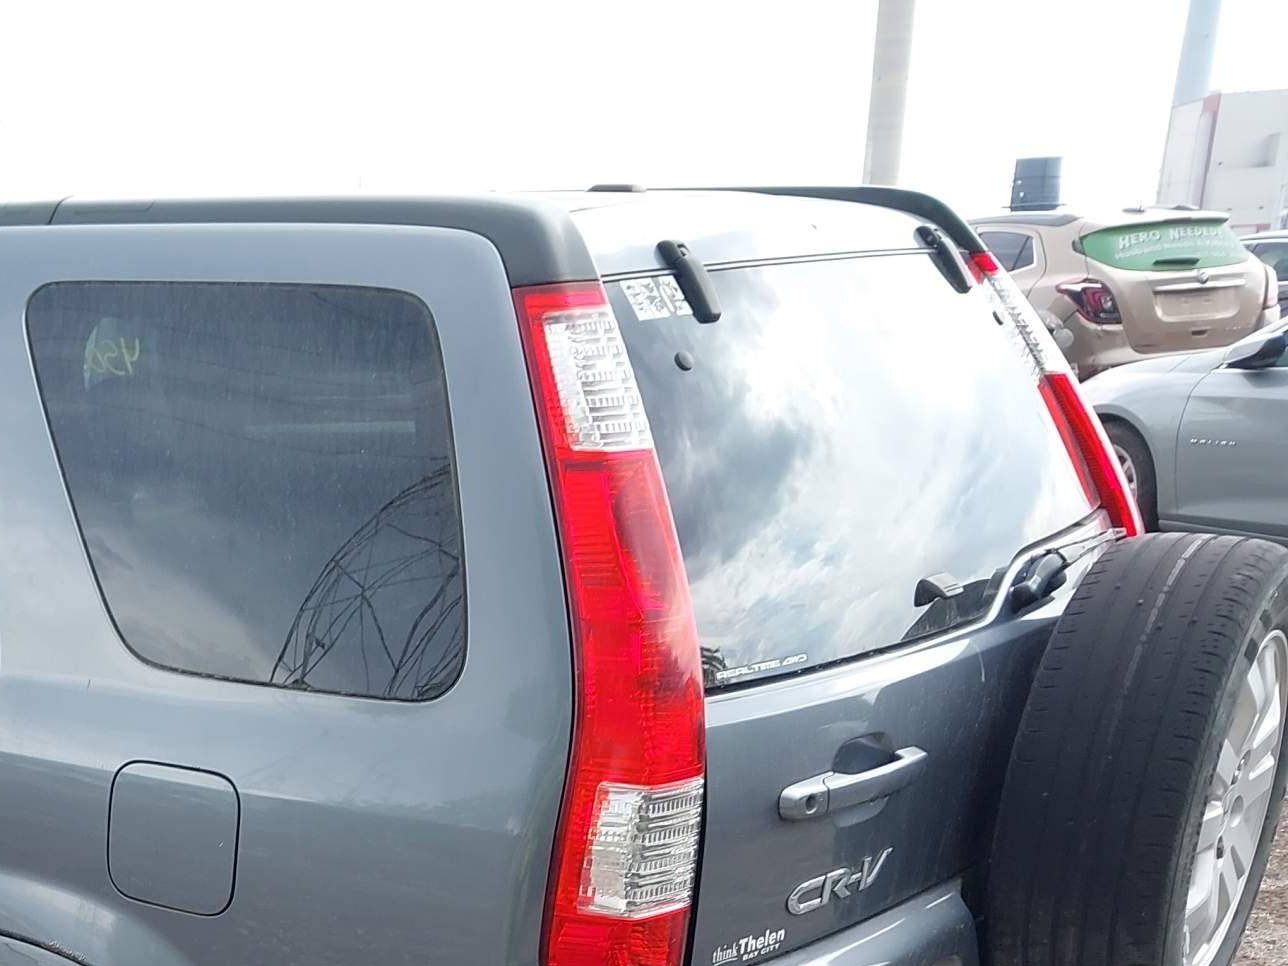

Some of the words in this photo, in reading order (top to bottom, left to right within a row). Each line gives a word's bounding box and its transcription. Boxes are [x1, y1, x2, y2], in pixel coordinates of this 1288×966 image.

[1118, 229, 1162, 250] HERO
[787, 847, 894, 916] CR-V
[712, 940, 739, 965] think
[738, 927, 786, 955] Thelen
[742, 951, 760, 962] BAY
[760, 943, 780, 955] CITY
